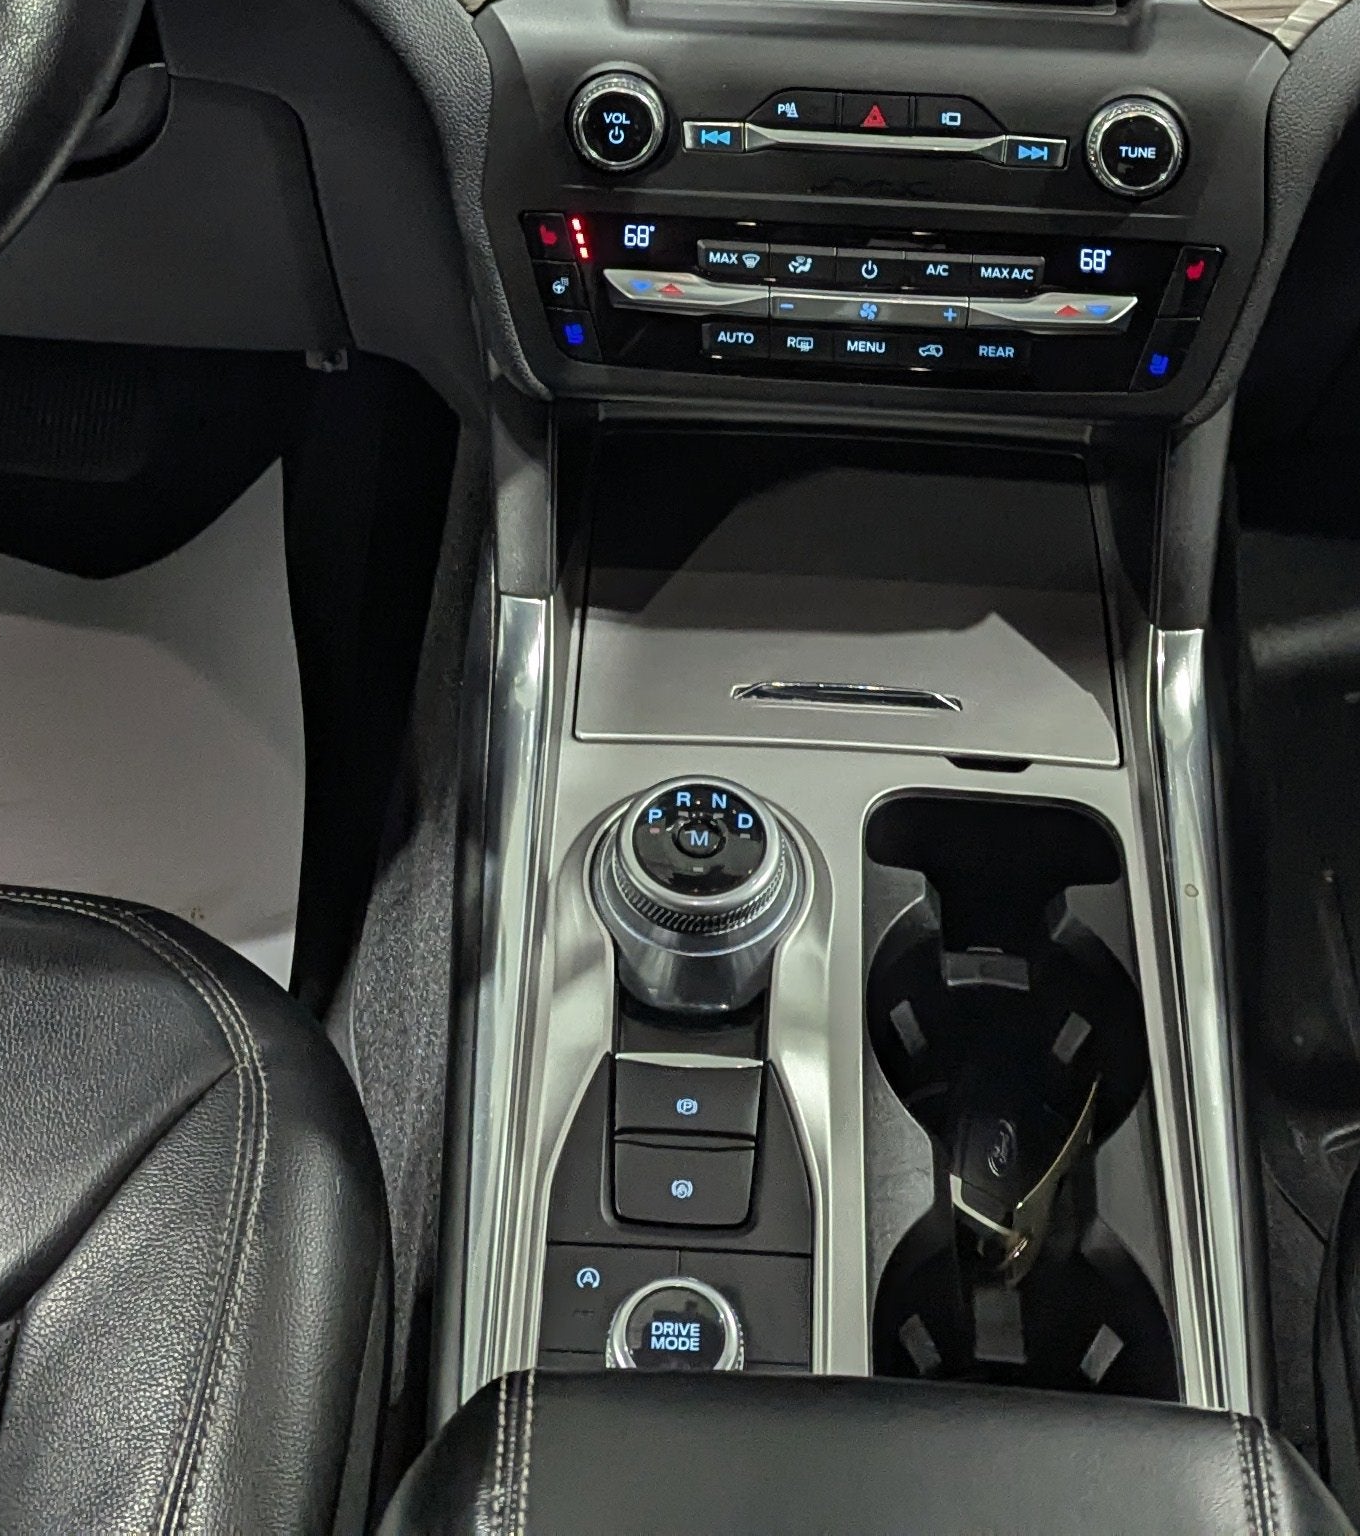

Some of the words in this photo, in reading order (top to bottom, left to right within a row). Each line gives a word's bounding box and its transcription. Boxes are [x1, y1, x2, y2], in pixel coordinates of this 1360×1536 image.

[603, 112, 630, 125] VOL
[1119, 146, 1157, 159] TUNE
[709, 251, 739, 265] MAX
[926, 264, 949, 277] A/C
[980, 266, 1009, 280] MAX
[1011, 268, 1034, 281] A/C
[717, 330, 755, 345] AUTO
[847, 340, 886, 354] MENU
[978, 345, 1015, 359] REAR
[648, 808, 663, 825] P
[676, 791, 691, 807] R
[711, 793, 727, 809] N
[737, 813, 754, 829] D
[690, 830, 709, 847] M
[650, 1321, 701, 1338] DRIVE
[650, 1335, 700, 1352] MODE
